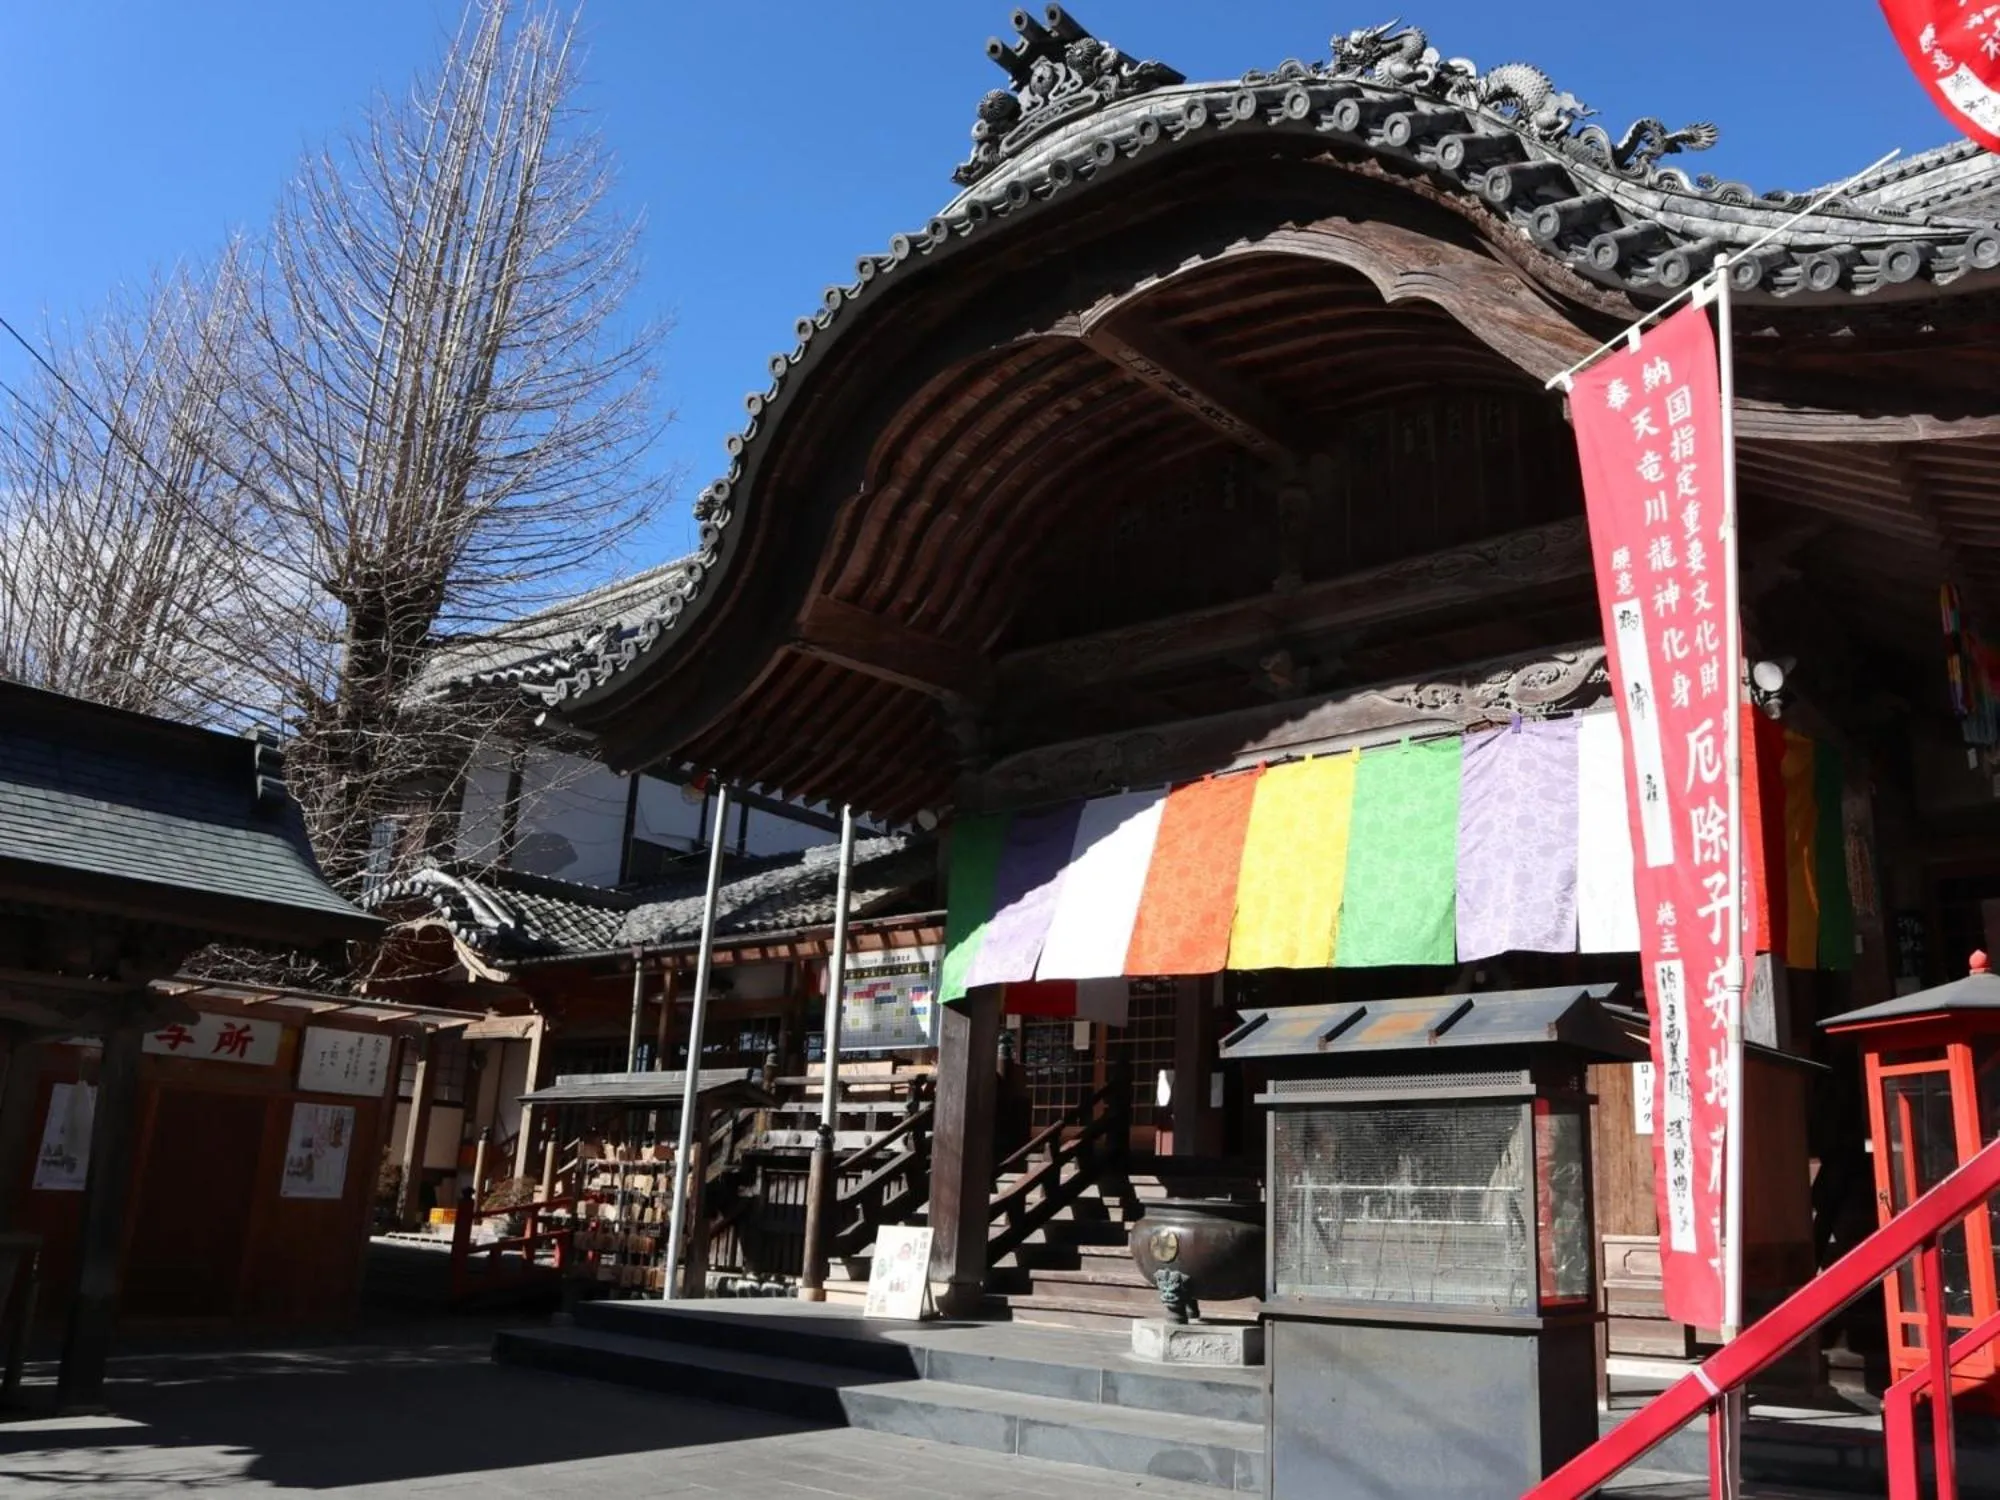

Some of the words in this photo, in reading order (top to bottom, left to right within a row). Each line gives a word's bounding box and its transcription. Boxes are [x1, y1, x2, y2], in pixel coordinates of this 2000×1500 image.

[1631, 406, 1691, 711] 天竜川龍神化身
[1665, 384, 1719, 699] 国指定重要文化財
[1655, 902, 1679, 955] 施主
[1641, 1064, 1651, 1123] ローソク
